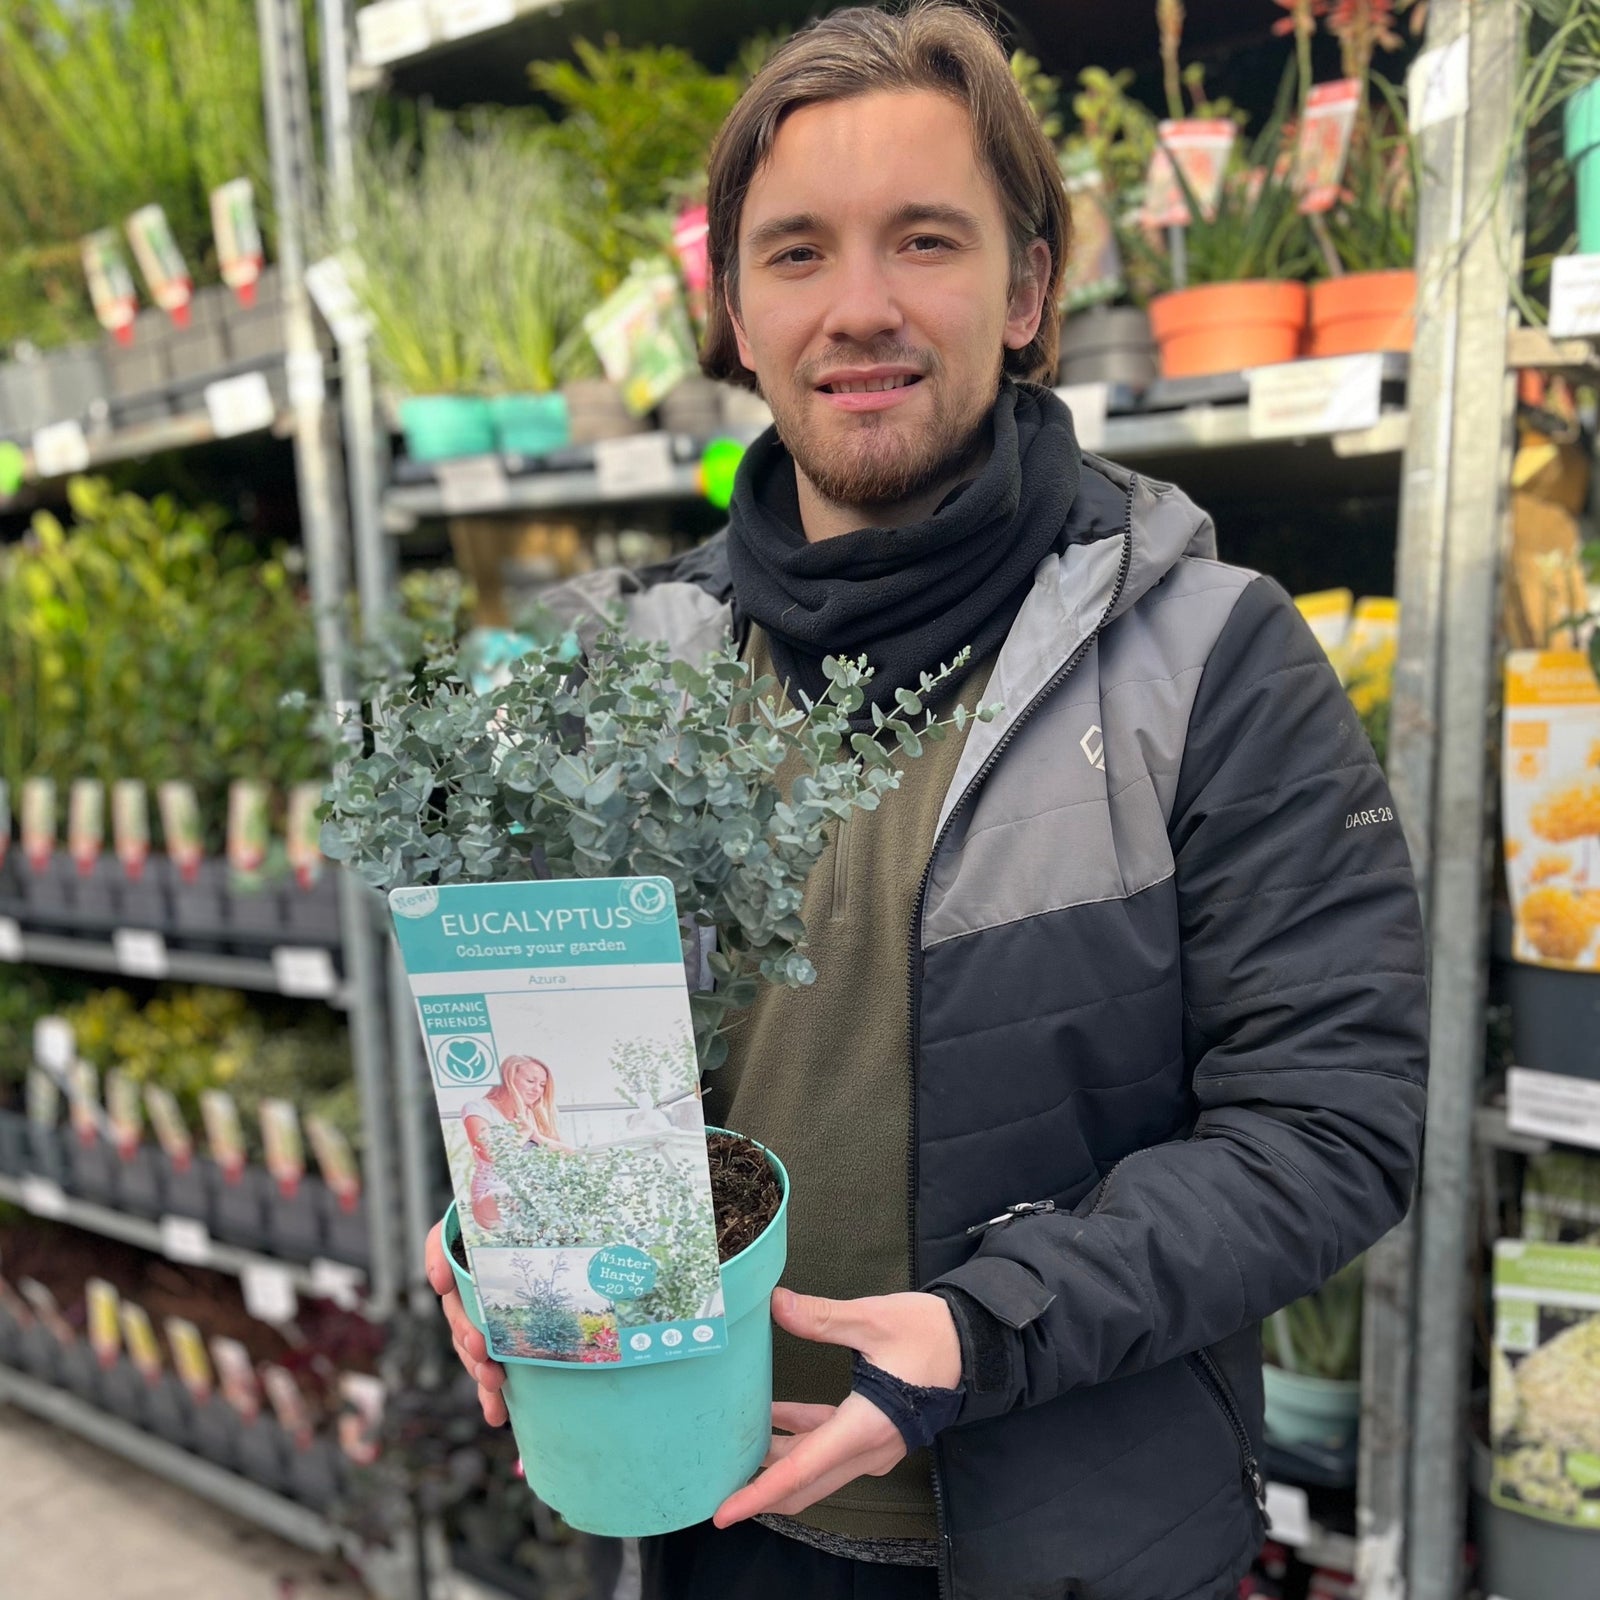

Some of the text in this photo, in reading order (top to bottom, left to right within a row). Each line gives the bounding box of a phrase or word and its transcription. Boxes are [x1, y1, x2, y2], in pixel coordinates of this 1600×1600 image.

[440, 906, 632, 936] EUCALYPTUS
[456, 939, 626, 958] Colours your garden
[528, 974, 567, 985] Azura
[423, 1001, 484, 1015] BOTANIC
[426, 1015, 488, 1029] FRIENDS
[600, 1251, 651, 1270] Winter
[600, 1266, 645, 1286] Hardy
[597, 1283, 624, 1295] -20
